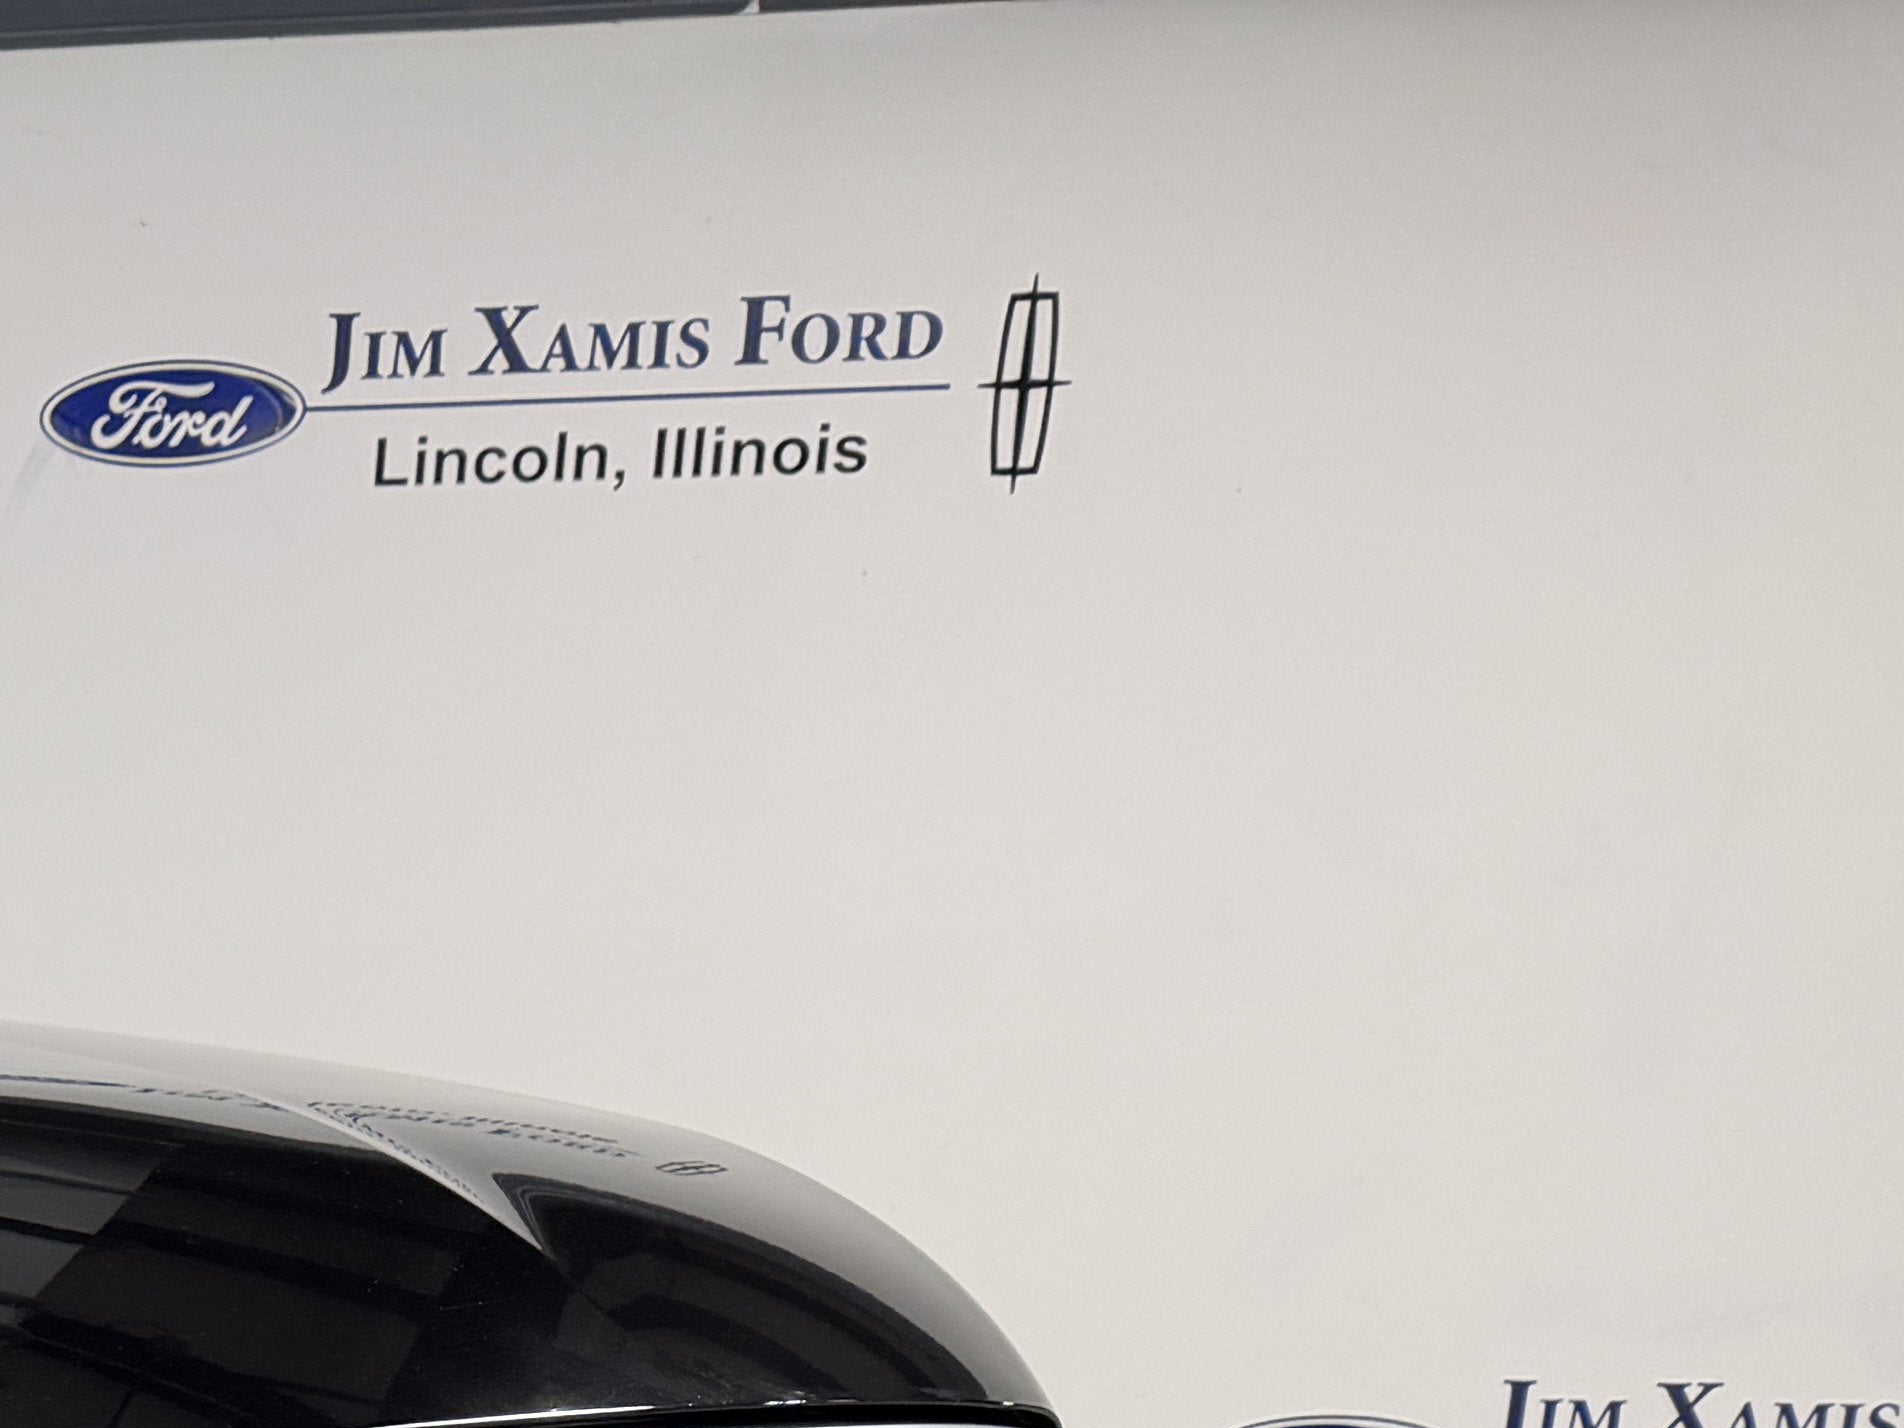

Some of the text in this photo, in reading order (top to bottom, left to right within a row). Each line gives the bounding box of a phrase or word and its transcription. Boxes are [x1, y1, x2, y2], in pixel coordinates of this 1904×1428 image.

[320, 294, 943, 395] JIM XAMIS FORD
[91, 380, 253, 449] Ford
[374, 422, 867, 491] Lincoln, Illinois
